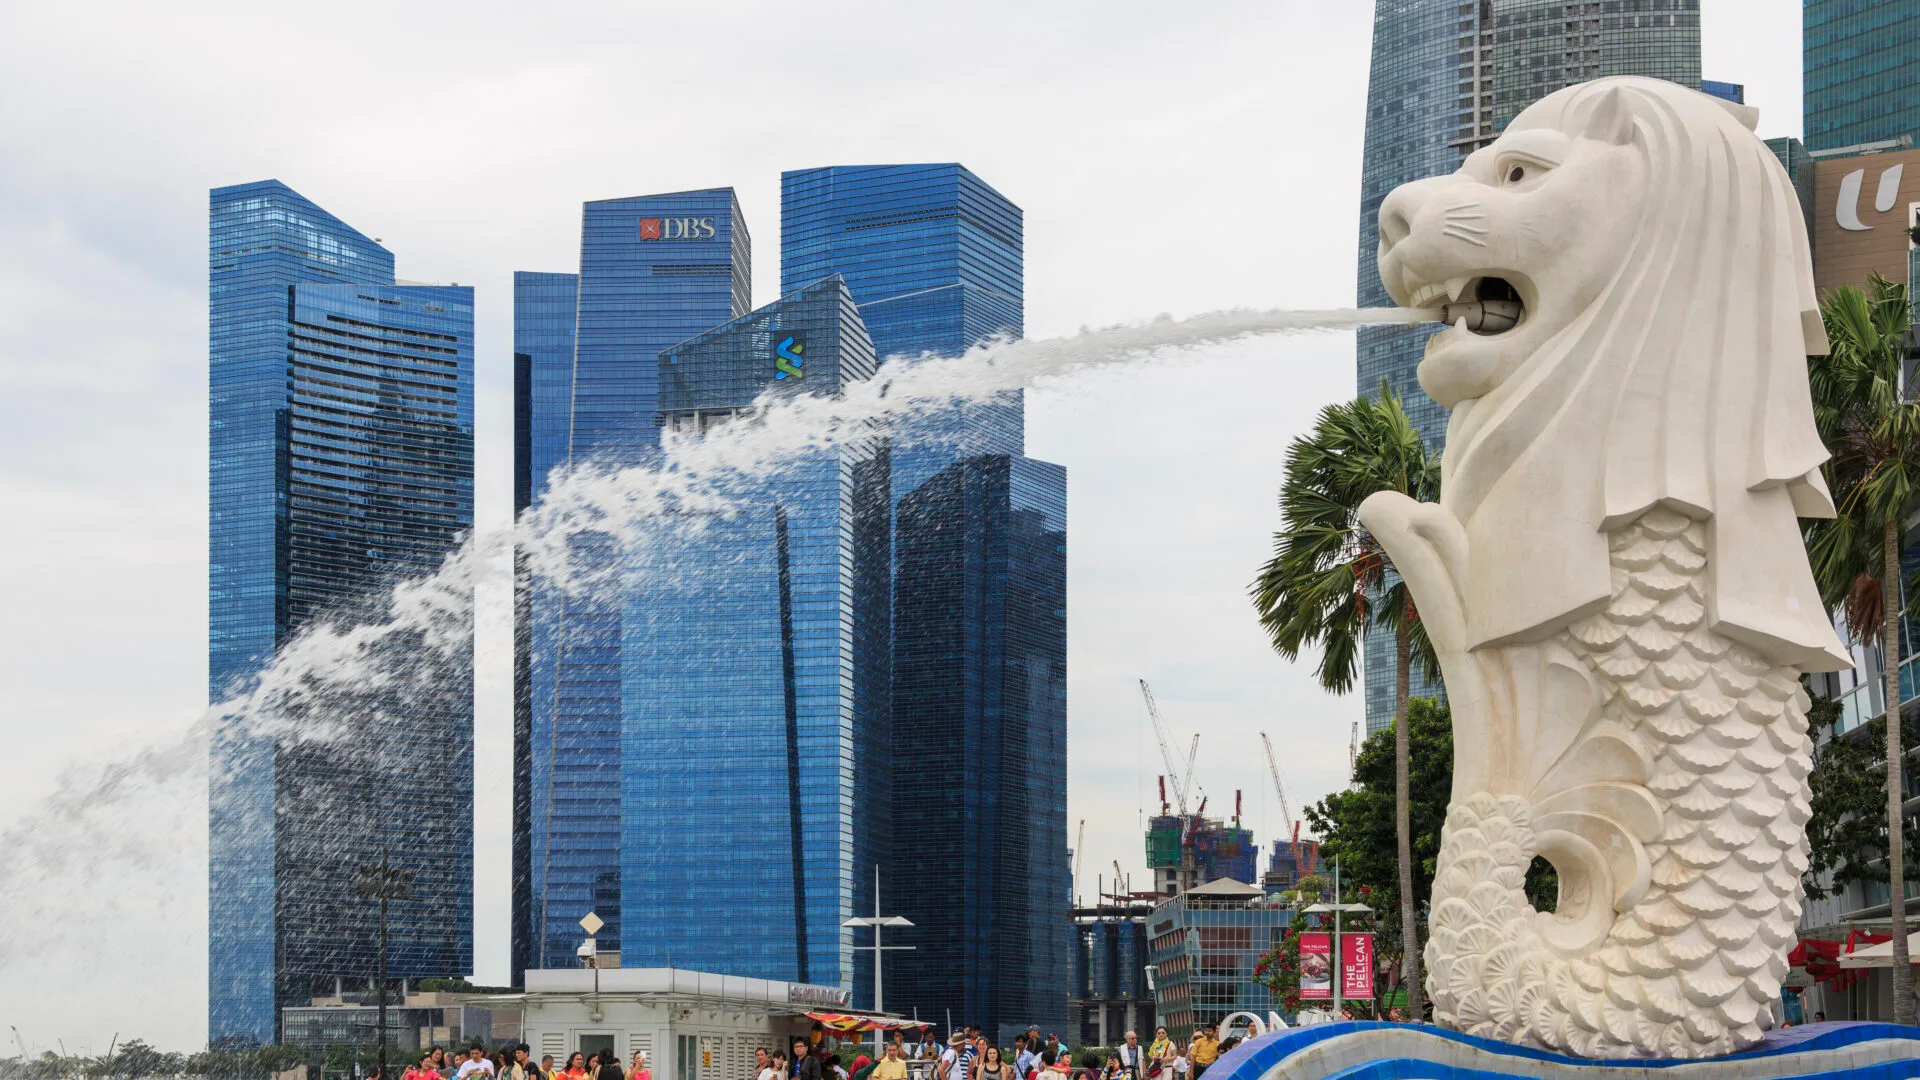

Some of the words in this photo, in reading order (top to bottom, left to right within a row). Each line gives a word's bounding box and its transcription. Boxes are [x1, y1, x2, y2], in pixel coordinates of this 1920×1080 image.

[664, 217, 715, 239] DBS
[1356, 937, 1365, 988] PELICAN
[1346, 965, 1356, 988] THE
